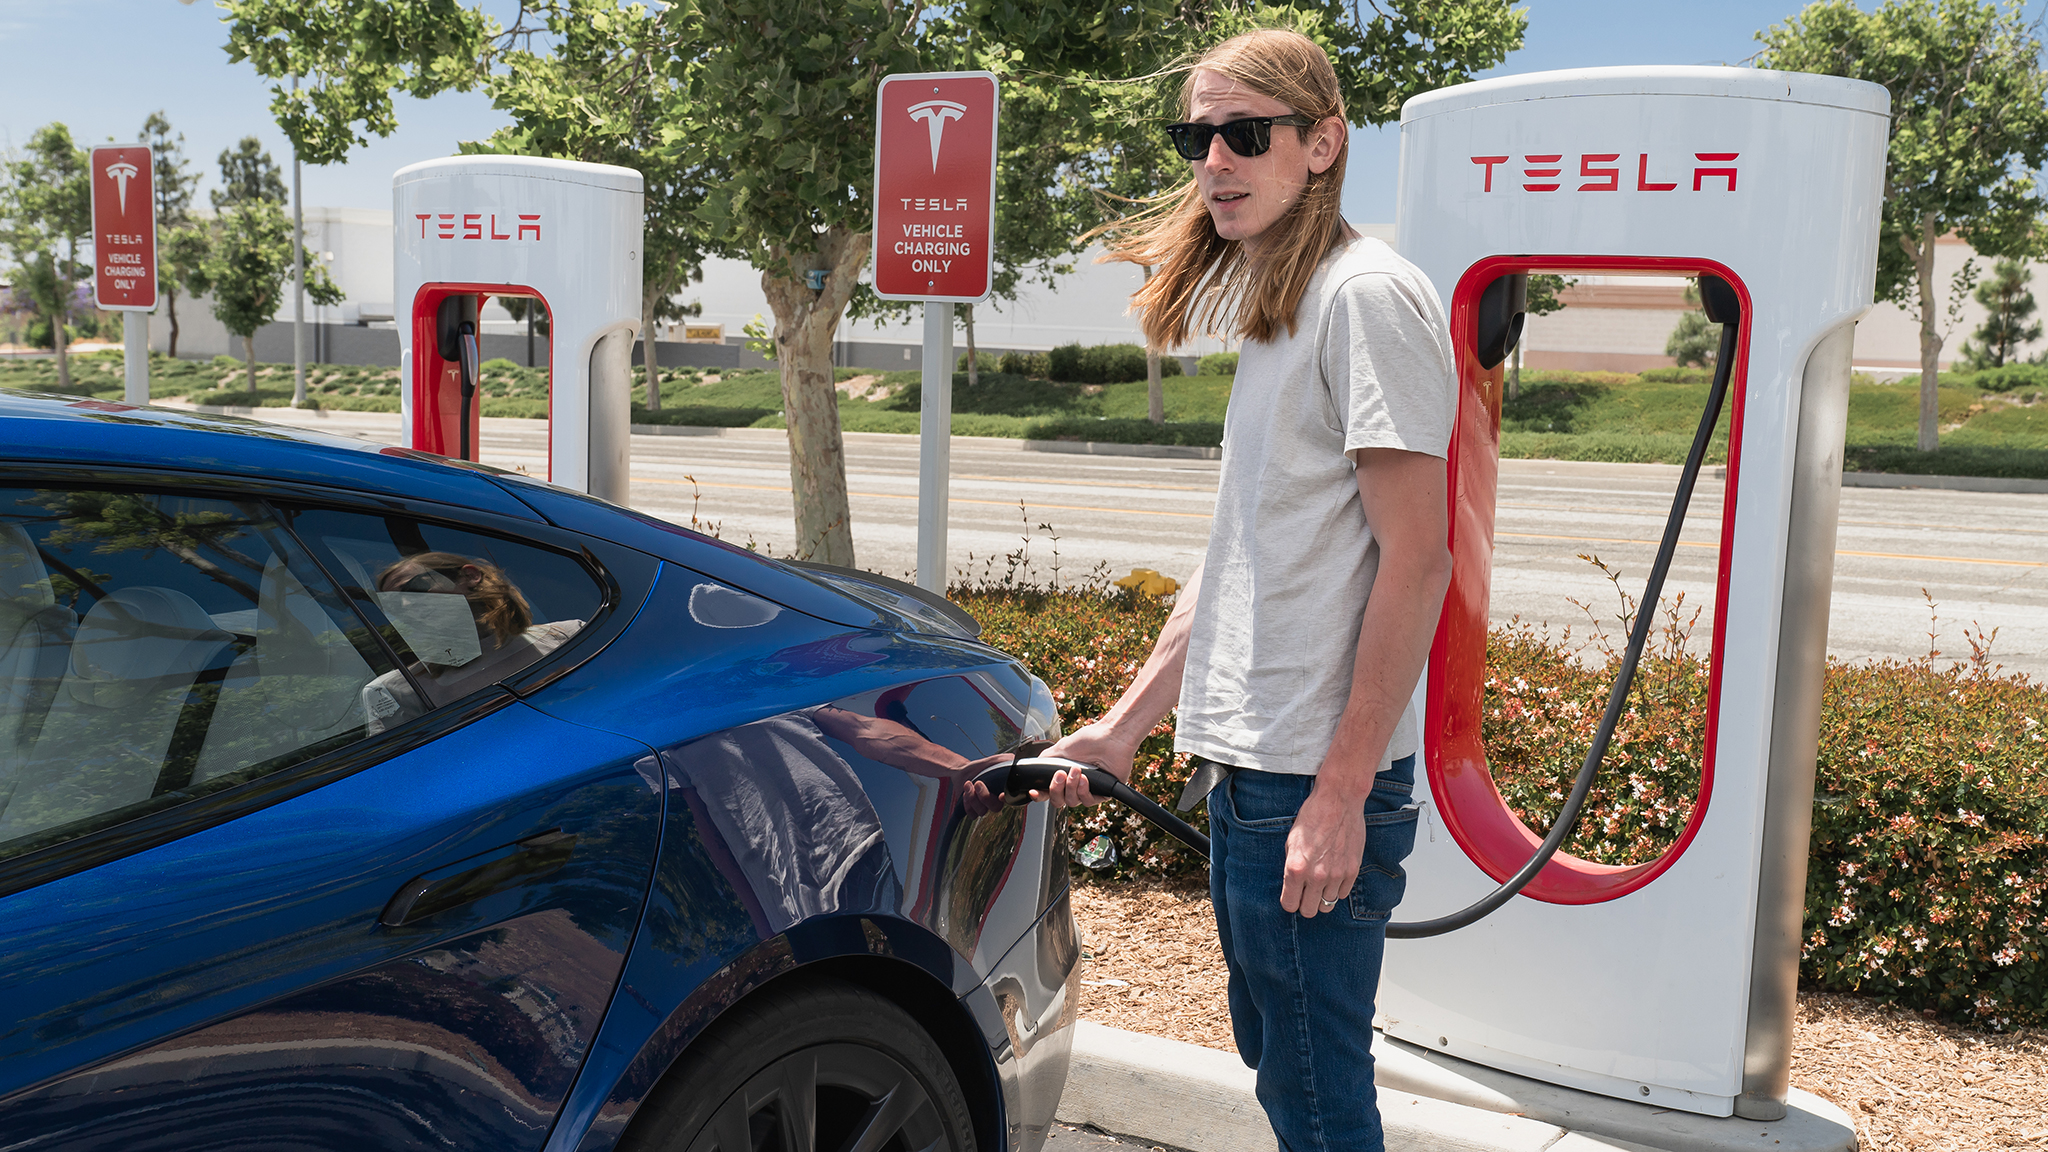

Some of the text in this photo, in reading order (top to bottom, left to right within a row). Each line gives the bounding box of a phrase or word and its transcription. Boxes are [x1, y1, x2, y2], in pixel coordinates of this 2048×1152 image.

[1470, 152, 1740, 192] TESLA
[900, 198, 967, 211] TESLA
[415, 214, 541, 241] TESLA
[902, 224, 963, 238] VEHICLE
[106, 234, 142, 244] TESLA
[894, 241, 970, 256] CHARGING
[108, 253, 141, 264] VEHICLE
[105, 266, 146, 277] CHARGING
[911, 259, 952, 273] ONLY
[114, 279, 136, 289] ONLY
[937, 1071, 974, 1152] MICHELI
